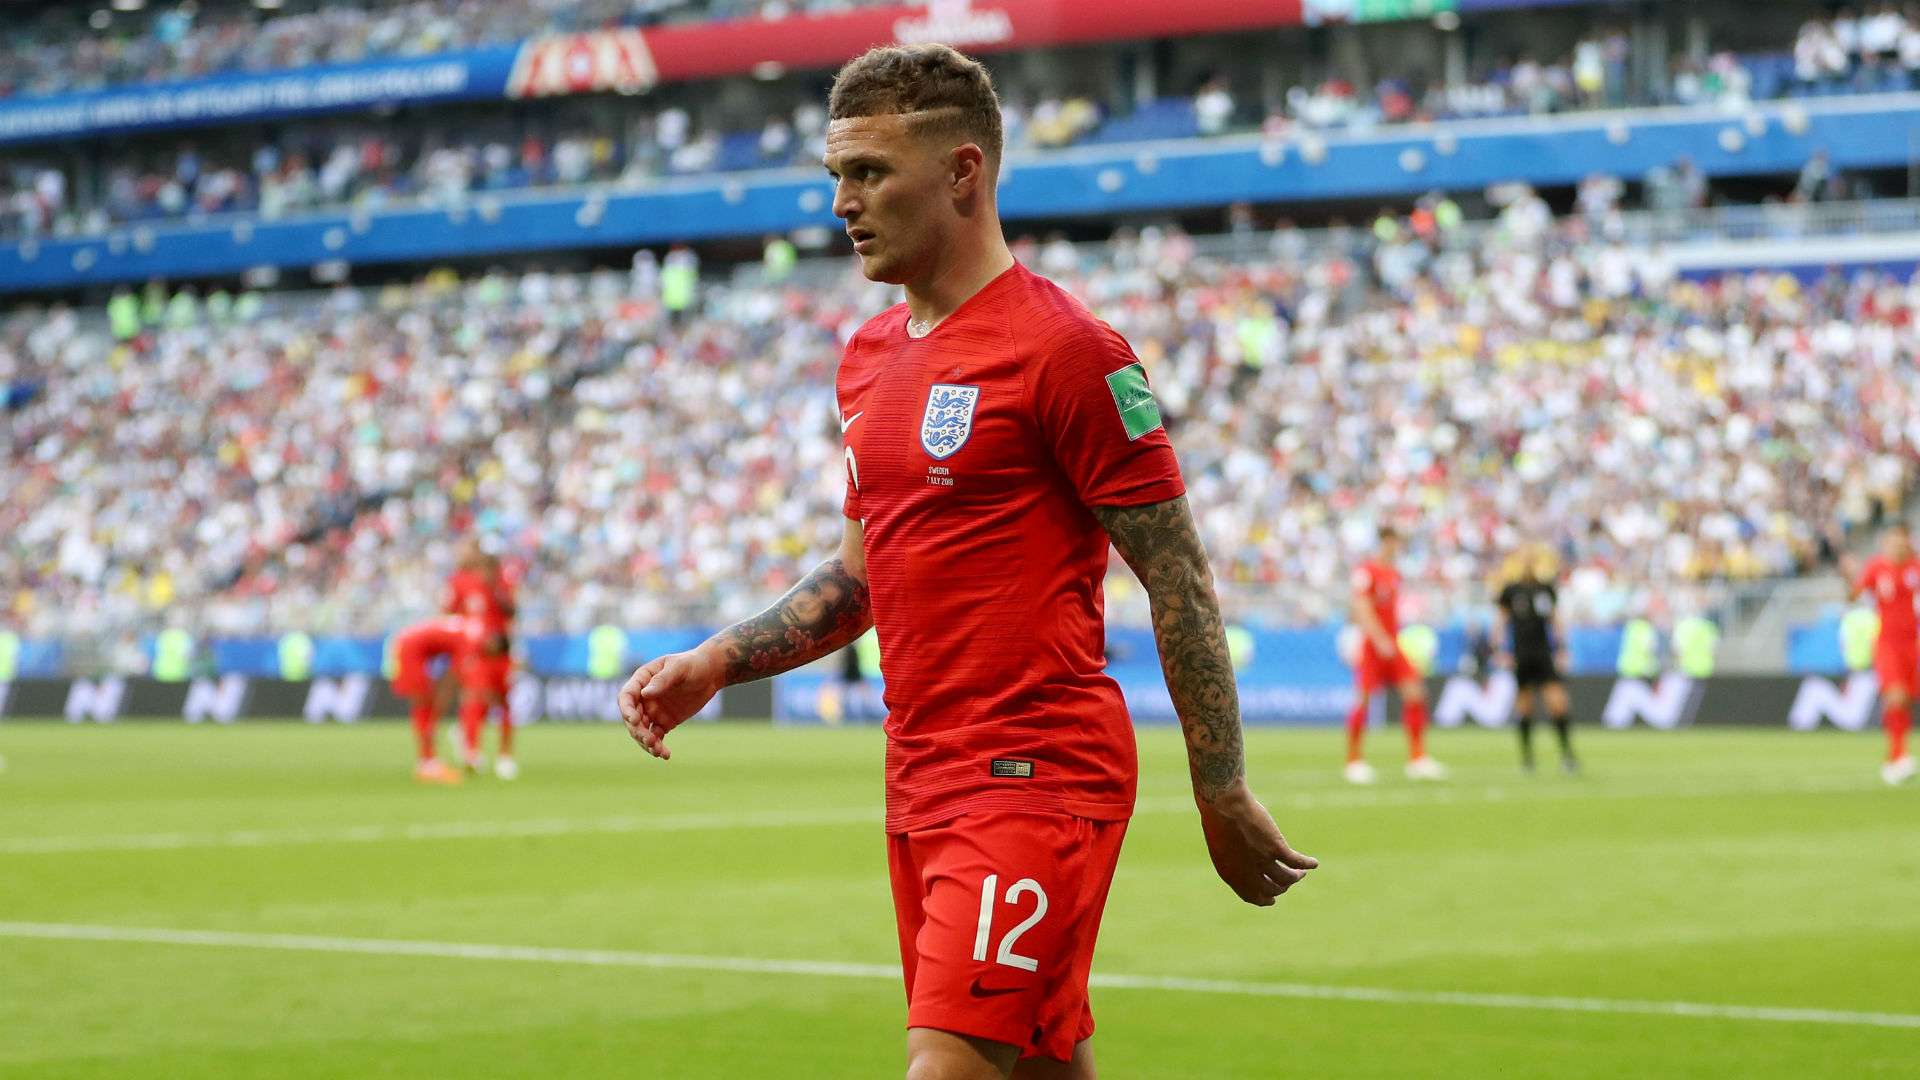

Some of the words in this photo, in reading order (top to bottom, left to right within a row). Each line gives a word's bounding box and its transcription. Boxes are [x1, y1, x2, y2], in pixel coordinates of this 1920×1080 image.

[928, 466, 949, 475] SWEDEN
[941, 477, 953, 485] 2018
[973, 874, 1048, 973] 12
